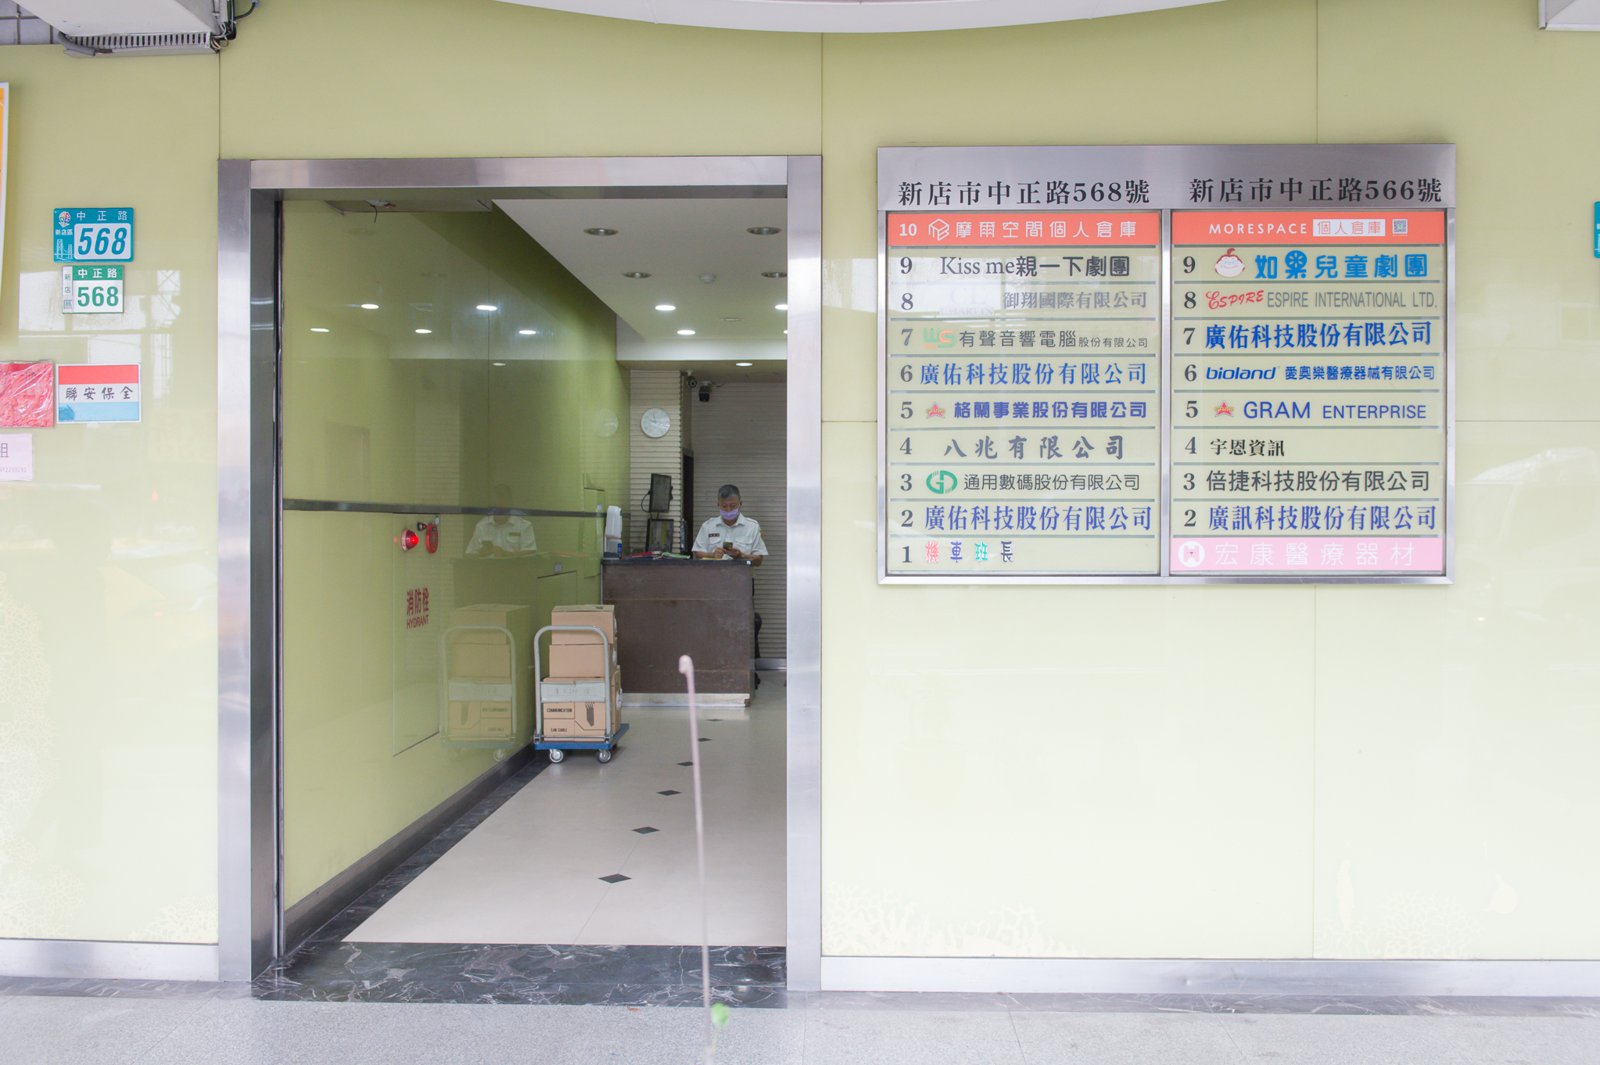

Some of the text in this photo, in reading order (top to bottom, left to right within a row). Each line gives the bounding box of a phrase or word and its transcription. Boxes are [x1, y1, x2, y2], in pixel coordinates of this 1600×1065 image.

[898, 180, 1150, 206] 新店市中正路568號
[1189, 177, 1442, 203] 新店市中正路566號
[76, 210, 128, 221] 中正路
[899, 220, 1137, 239] 10 摩爾空間個人倉庫
[1208, 220, 1382, 235] MORESPACE 個人倉庫
[77, 227, 128, 255] 568
[77, 267, 118, 279] 中正路
[900, 256, 913, 275] 9
[940, 256, 981, 275] Kiss
[1183, 249, 1428, 279] 9 如果兒童劇團
[77, 286, 119, 307] 568
[901, 292, 914, 311] 8
[1002, 291, 1148, 309] 御翔國際有限公司
[1184, 291, 1197, 309] 8
[1267, 292, 1309, 308] ESPIRE
[1315, 291, 1406, 308] INTERNATIONAL
[1412, 291, 1438, 308] LTD.
[901, 328, 914, 346] 7
[1183, 320, 1432, 349] 7 廣佑科技股份有限公司
[900, 362, 1147, 385] 6 廣佑科技股份有限公司
[1184, 364, 1197, 382] 6
[1206, 366, 1277, 380] bioland
[65, 386, 133, 401] 聯安保全
[900, 401, 914, 419] 5
[954, 401, 1148, 419] 格蘭事業股份有限公司
[1185, 400, 1198, 418] 5
[1243, 401, 1311, 419] GRAM
[1322, 404, 1427, 419] ENTERPRISE
[900, 435, 1125, 460] 4 八兆有限公司
[1184, 436, 1285, 457] 4 宇恩資訊
[900, 474, 913, 491] 3
[963, 473, 1140, 491] 通用數碼股份有限公司
[1183, 469, 1430, 492] 3 倍捷科技股份有限公司
[901, 505, 1152, 531] 2 廣佑科技股份有限公司
[1184, 504, 1437, 531] 2 廣訊科技股份有限公司
[902, 545, 914, 563] 1
[1215, 542, 1415, 566] 宏康醫療器材
[406, 587, 430, 616] 消防栓
[406, 615, 430, 630] HYDRANT
